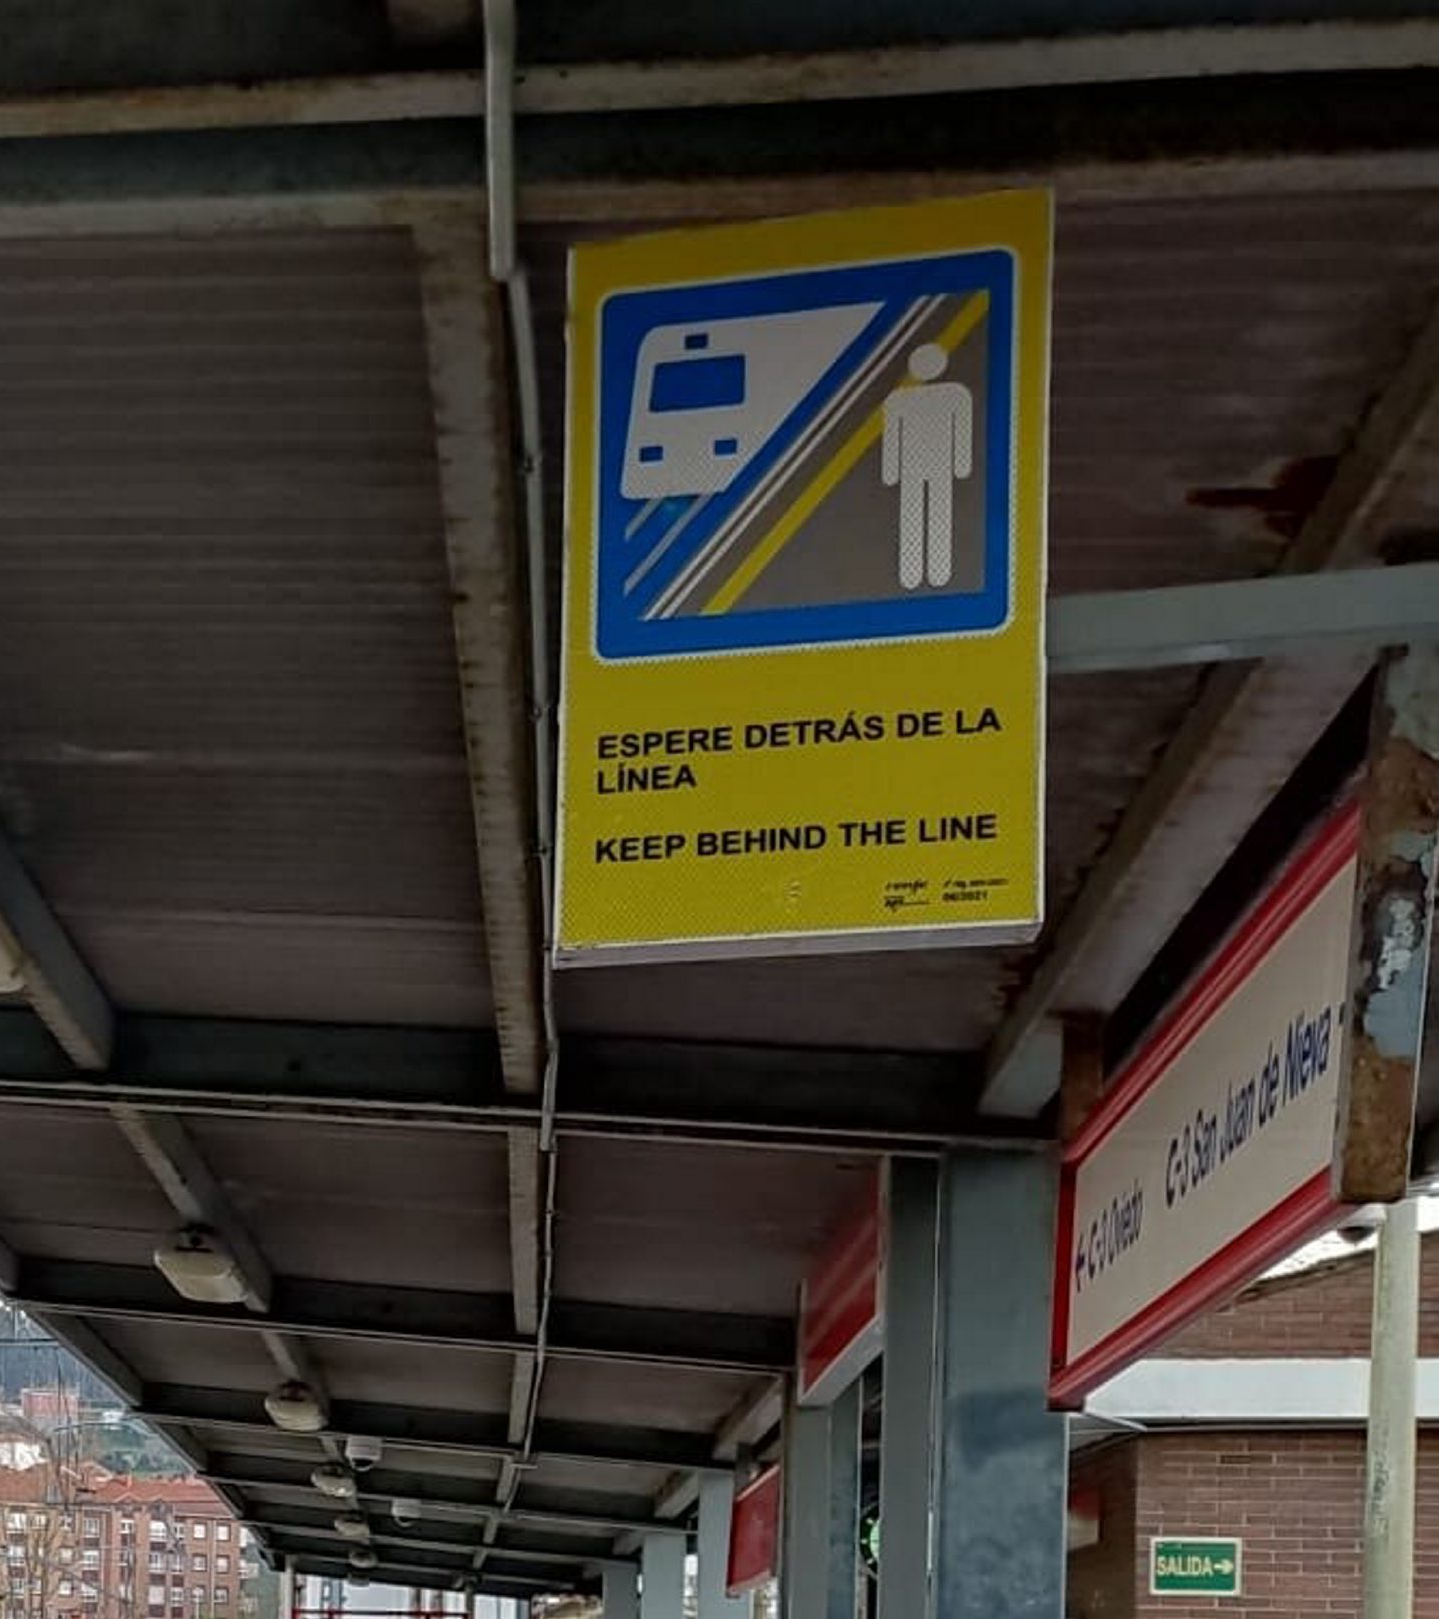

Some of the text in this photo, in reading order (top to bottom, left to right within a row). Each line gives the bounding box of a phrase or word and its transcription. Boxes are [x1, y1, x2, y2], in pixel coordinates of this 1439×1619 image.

[598, 707, 1001, 759] ESPERE DETRÁS DE LA
[597, 763, 696, 794] LÍNEA
[595, 814, 997, 863] KEEP BEHIND THE LINE
[1166, 1006, 1332, 1209] C-3 San Juan de Nieva
[1109, 1178, 1143, 1265] Oviedo
[1157, 1555, 1214, 1577] SALIDA
